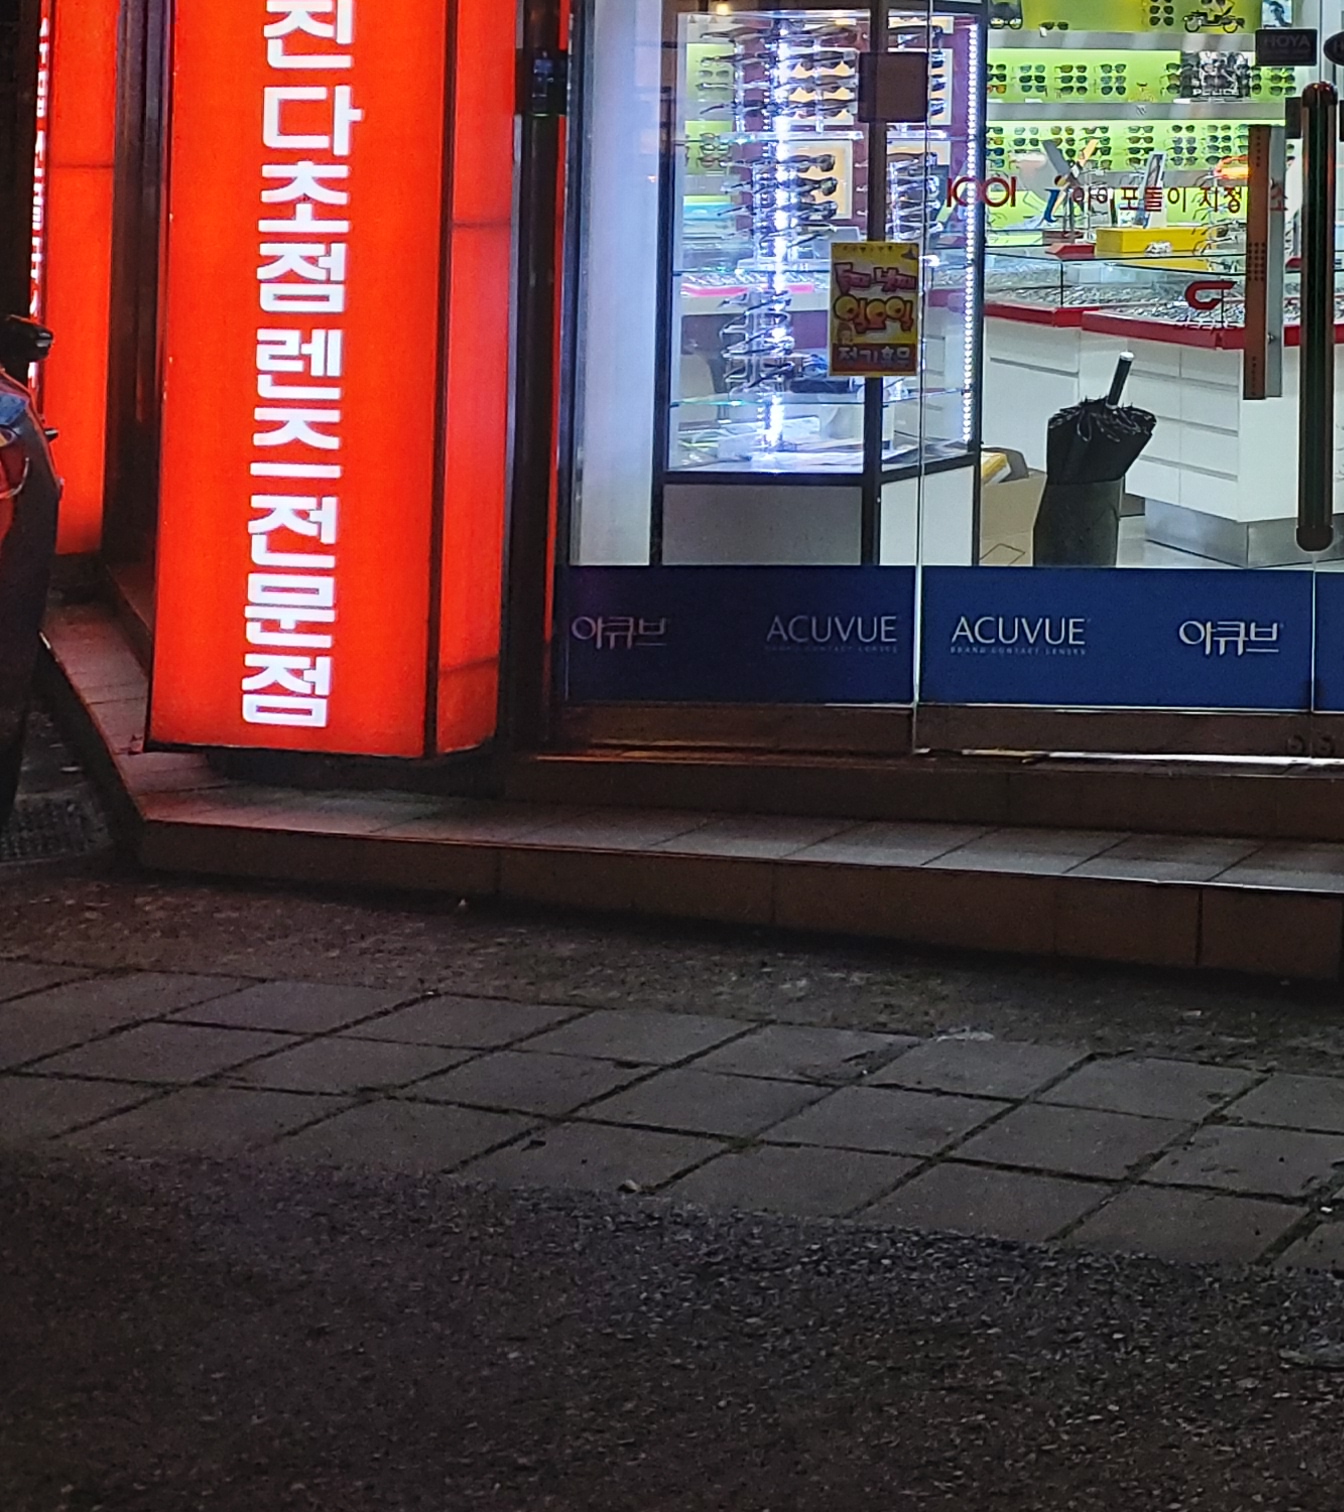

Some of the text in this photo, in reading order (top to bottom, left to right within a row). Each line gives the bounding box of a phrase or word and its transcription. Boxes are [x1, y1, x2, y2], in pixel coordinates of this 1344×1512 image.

[1263, 35, 1311, 48] HOYA
[947, 177, 1017, 208] 1001
[571, 614, 668, 649] 아큐브
[766, 614, 898, 644] ACUVUE
[951, 614, 1087, 647] ACUVUE
[1179, 620, 1280, 657] 아큐브
